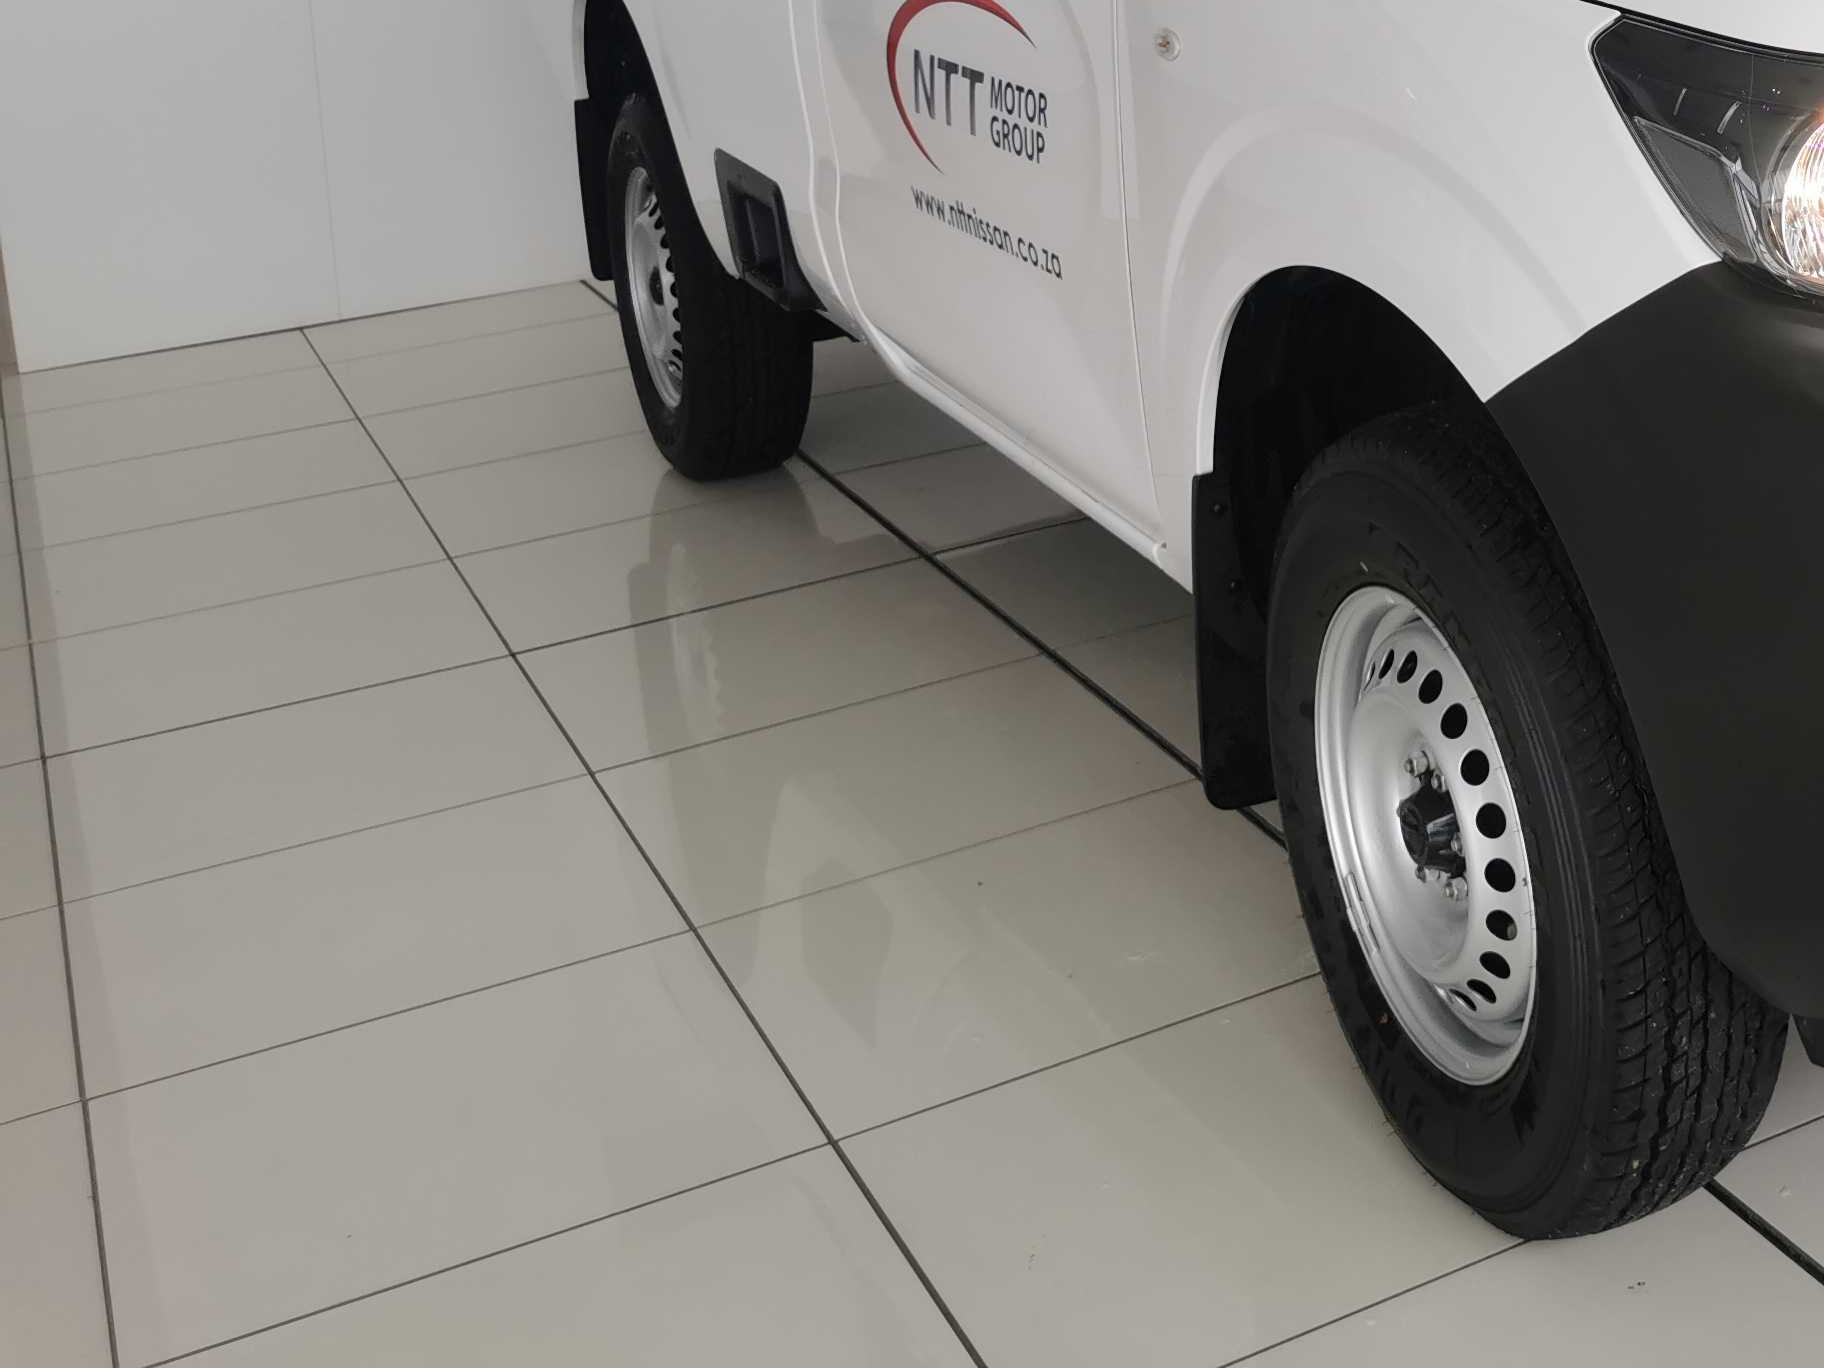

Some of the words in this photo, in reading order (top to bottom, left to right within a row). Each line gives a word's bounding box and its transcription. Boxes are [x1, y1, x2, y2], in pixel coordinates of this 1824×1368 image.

[913, 49, 984, 136] NTT
[990, 76, 1048, 128] MOTOR
[989, 116, 1046, 164] GROUP
[911, 184, 1063, 281] www.nttnissan.co.za
